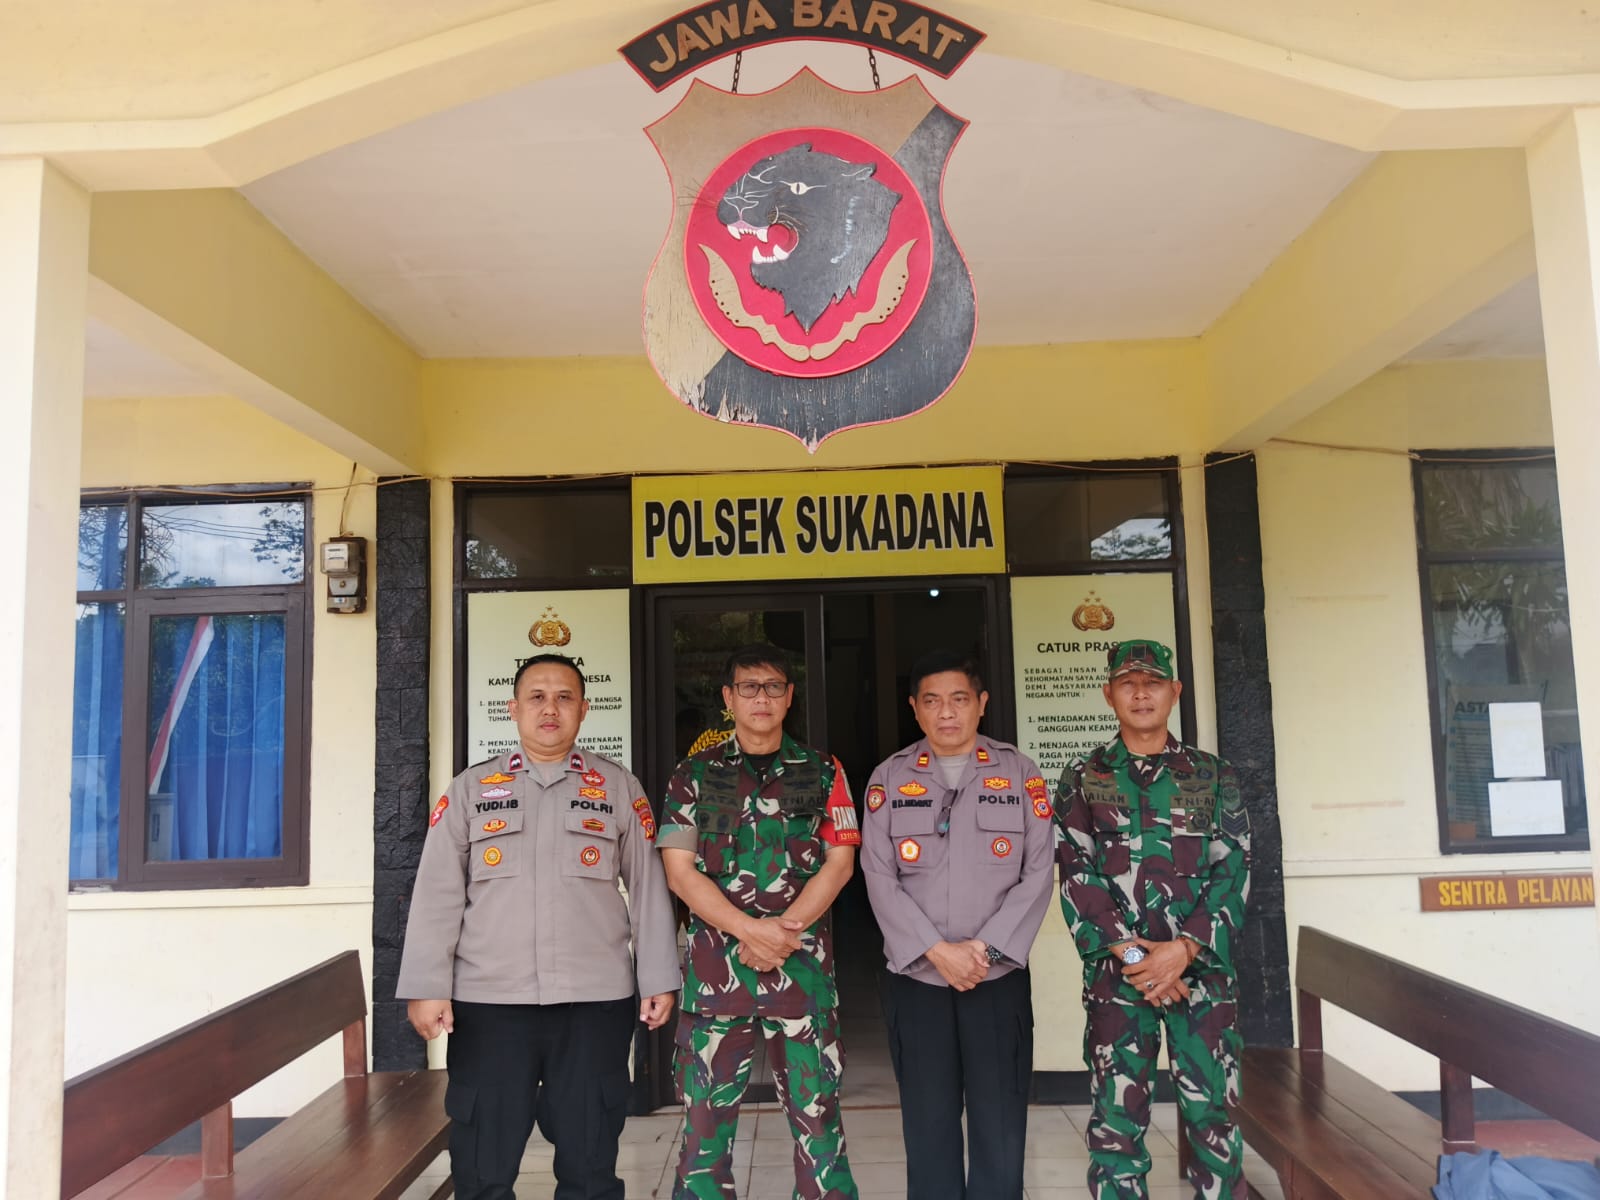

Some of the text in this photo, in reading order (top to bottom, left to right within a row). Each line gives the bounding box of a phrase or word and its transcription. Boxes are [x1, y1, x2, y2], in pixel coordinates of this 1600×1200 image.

[649, 0, 965, 73] JAWA BARAT
[645, 491, 994, 558] POLSEK SUKADANA
[1037, 642, 1081, 653] CATUR
[1024, 667, 1063, 675] SEBAGAI
[488, 674, 612, 686] KAMI NESIA
[1024, 675, 1074, 683] KEHORMATAN
[1028, 715, 1036, 723] 1.
[1037, 714, 1096, 723] MENIADAKAN
[1037, 725, 1086, 733] GANGGUAN
[1029, 742, 1037, 750] 2.
[1039, 741, 1080, 750] MENJAGA
[1039, 751, 1063, 759] RAGA
[978, 794, 1020, 806] POLRI
[475, 799, 613, 814] YUDI.IB POLRI
[1438, 877, 1594, 906] SENTRA PELAYAN
